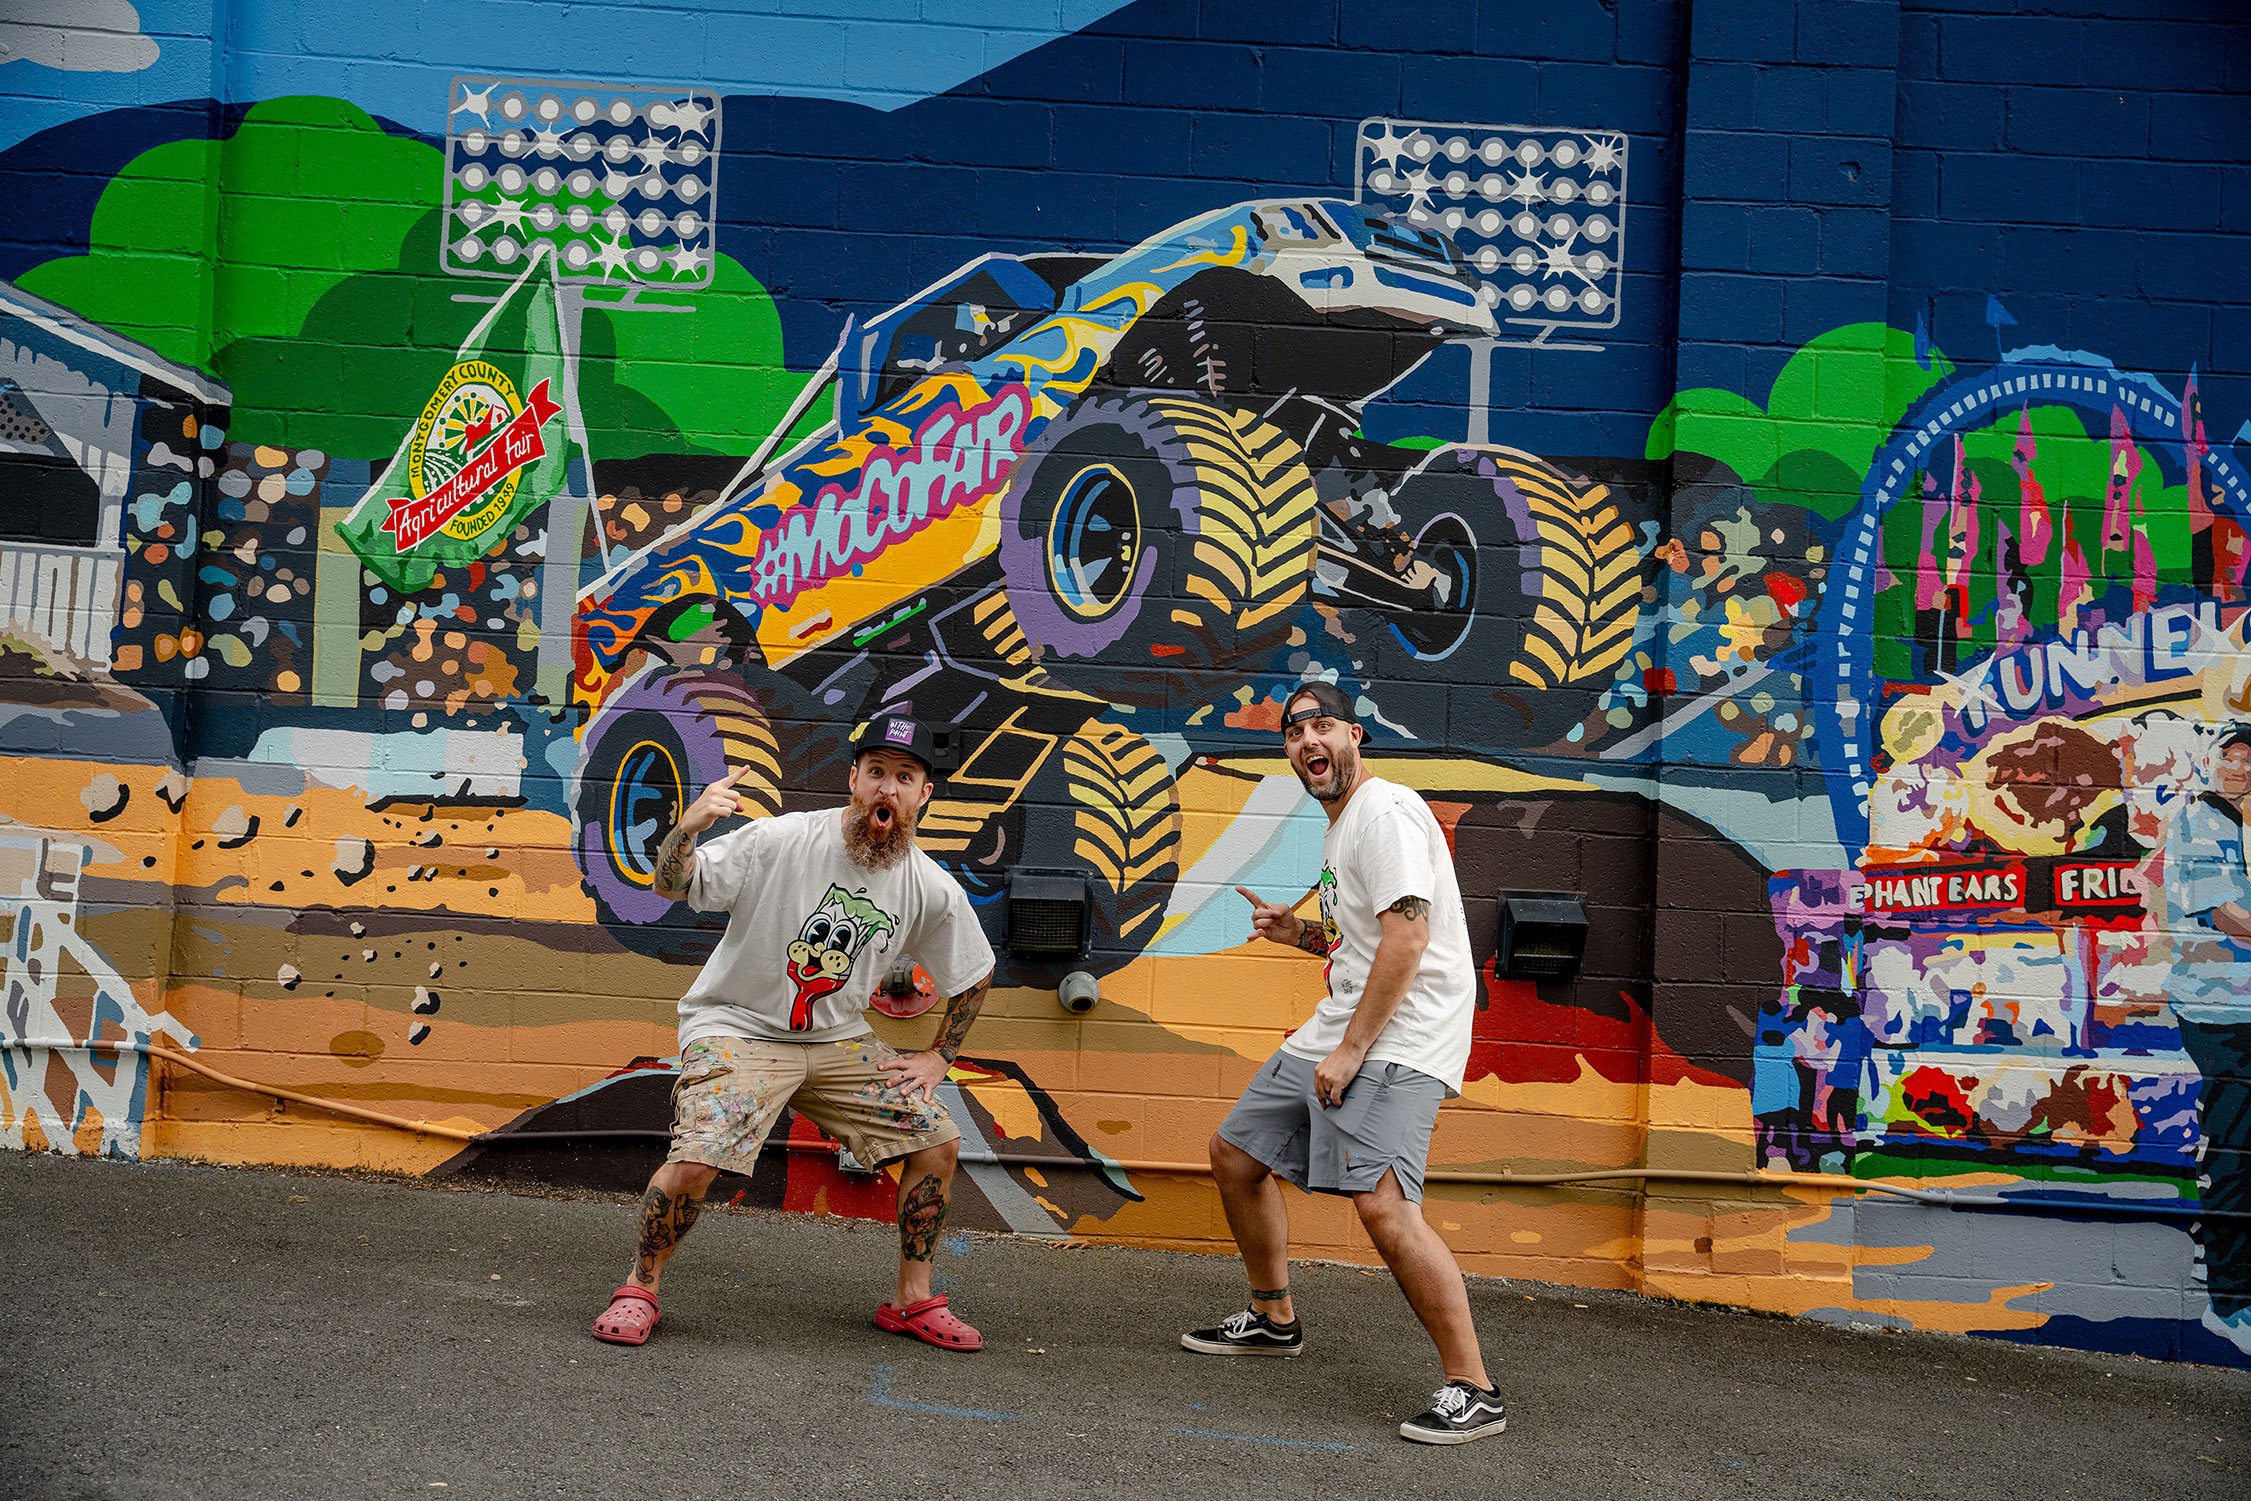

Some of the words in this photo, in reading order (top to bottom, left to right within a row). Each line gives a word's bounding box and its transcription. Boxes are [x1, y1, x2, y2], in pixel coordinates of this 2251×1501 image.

[411, 370, 458, 478] MONTGOMERY
[459, 363, 514, 396] COUNTY
[399, 447, 498, 552] Agricultural
[505, 428, 534, 465] Fair
[449, 510, 495, 536] FOUNDED
[493, 482, 515, 512] 1949
[1948, 873, 2018, 901] EARS
